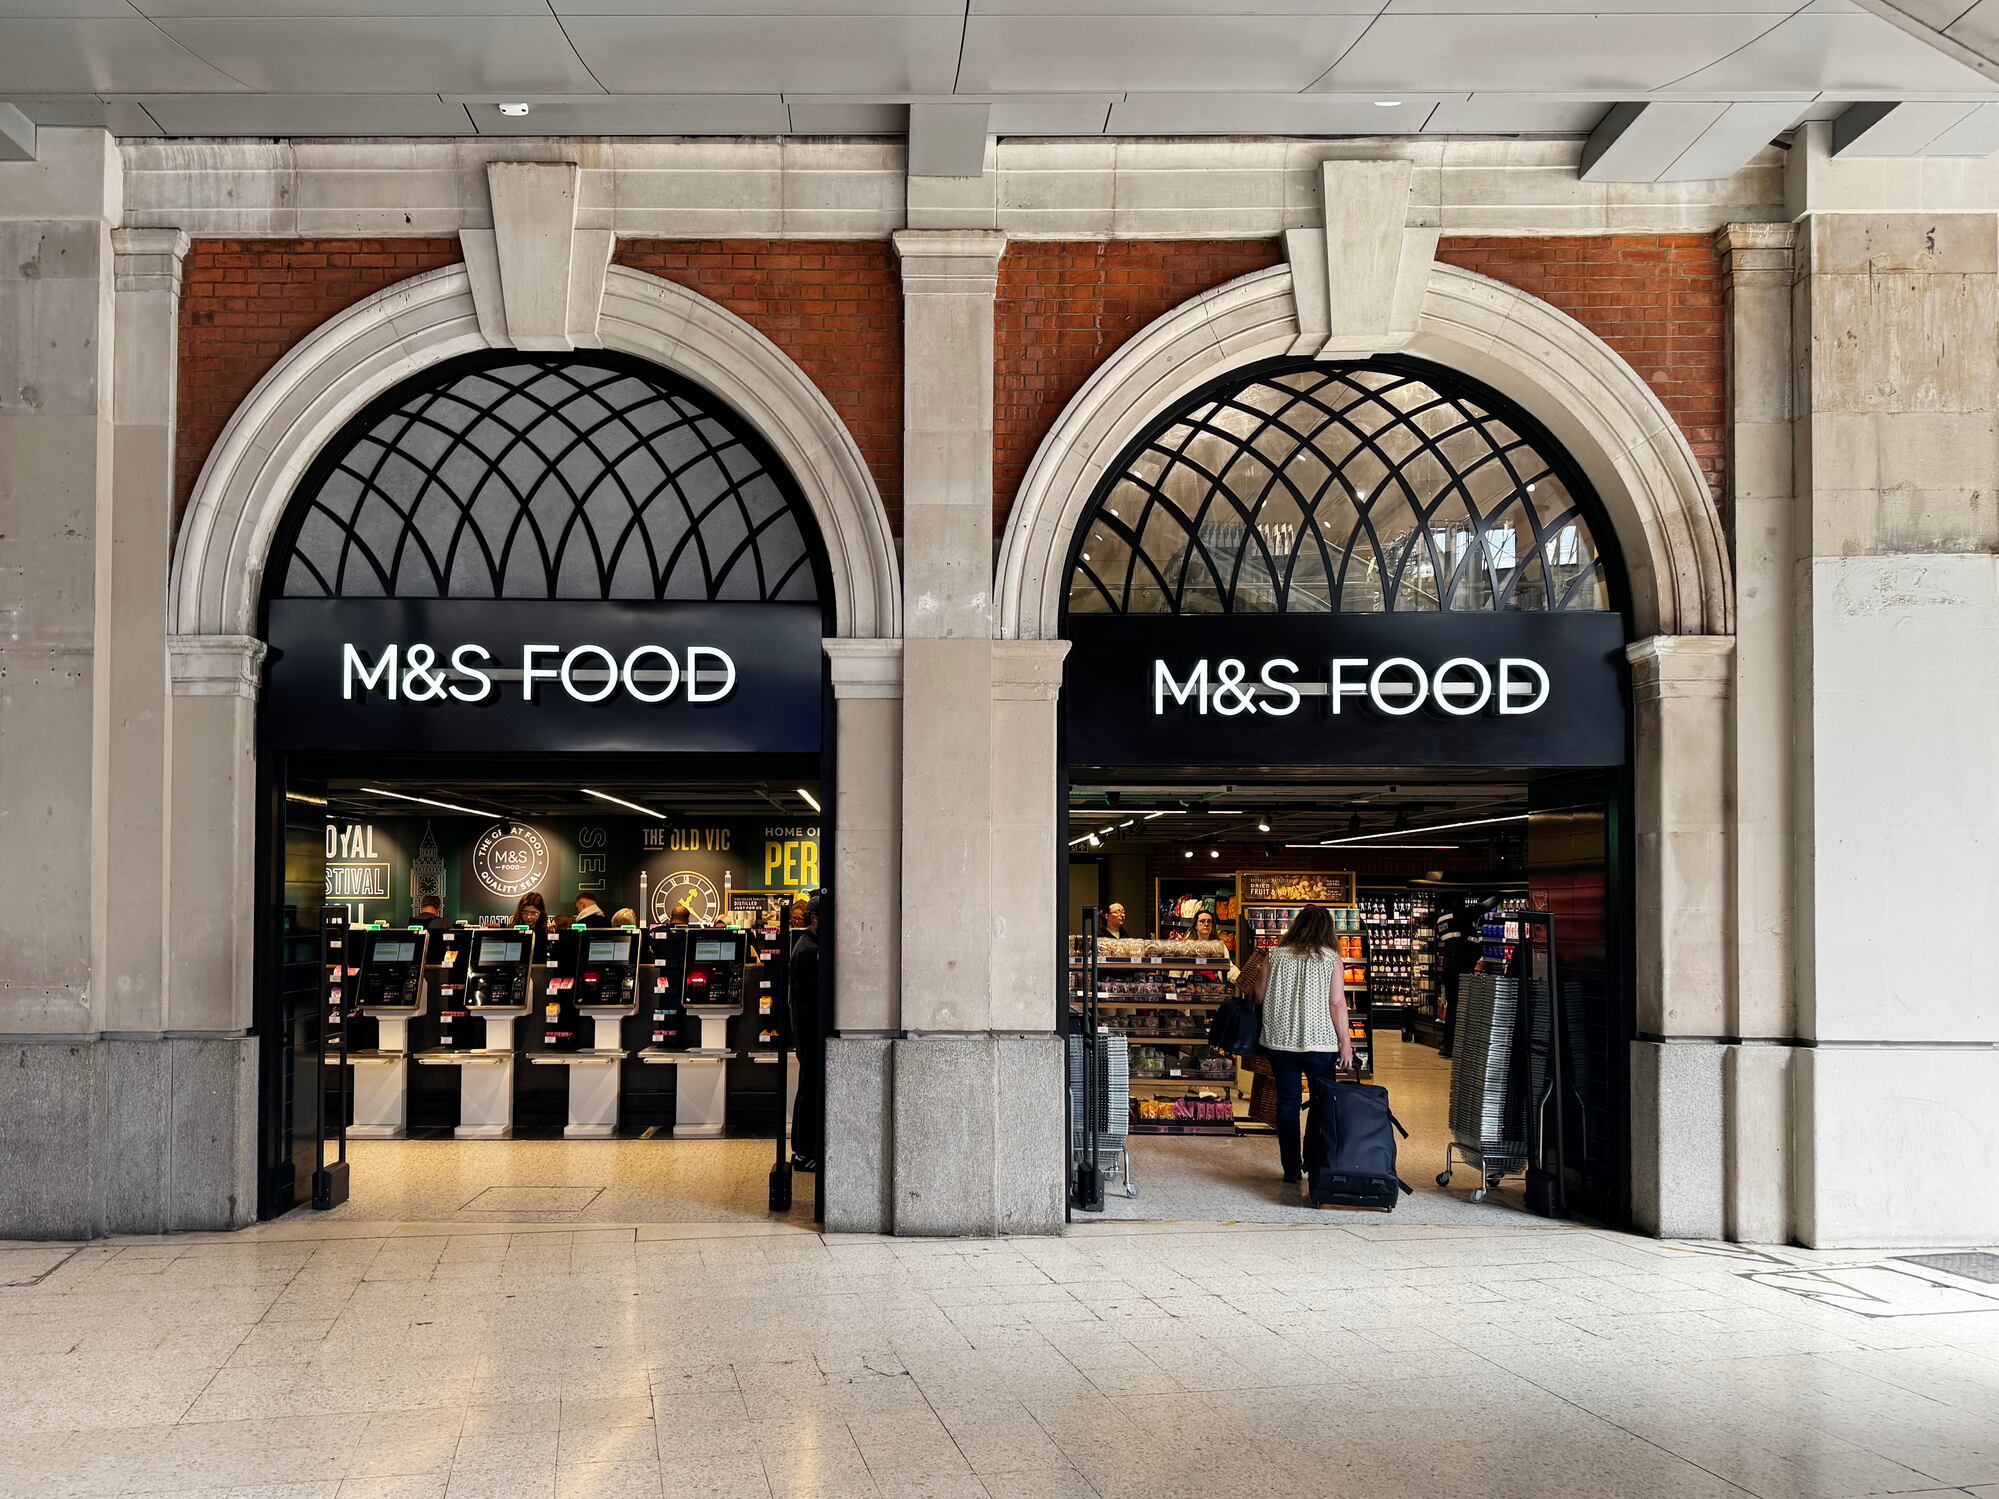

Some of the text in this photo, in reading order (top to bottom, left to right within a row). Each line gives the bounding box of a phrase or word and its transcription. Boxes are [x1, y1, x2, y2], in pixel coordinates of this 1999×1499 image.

[343, 643, 736, 702] M&S FOOD
[1154, 657, 1550, 716] M&S FOOD
[478, 827, 544, 857] THE GAT FOOD
[643, 828, 731, 851] THE OLD VIC
[765, 827, 803, 837] HOME
[495, 850, 528, 864] M&S
[764, 841, 820, 886] PER
[481, 871, 542, 893] QUALITY SEAL
